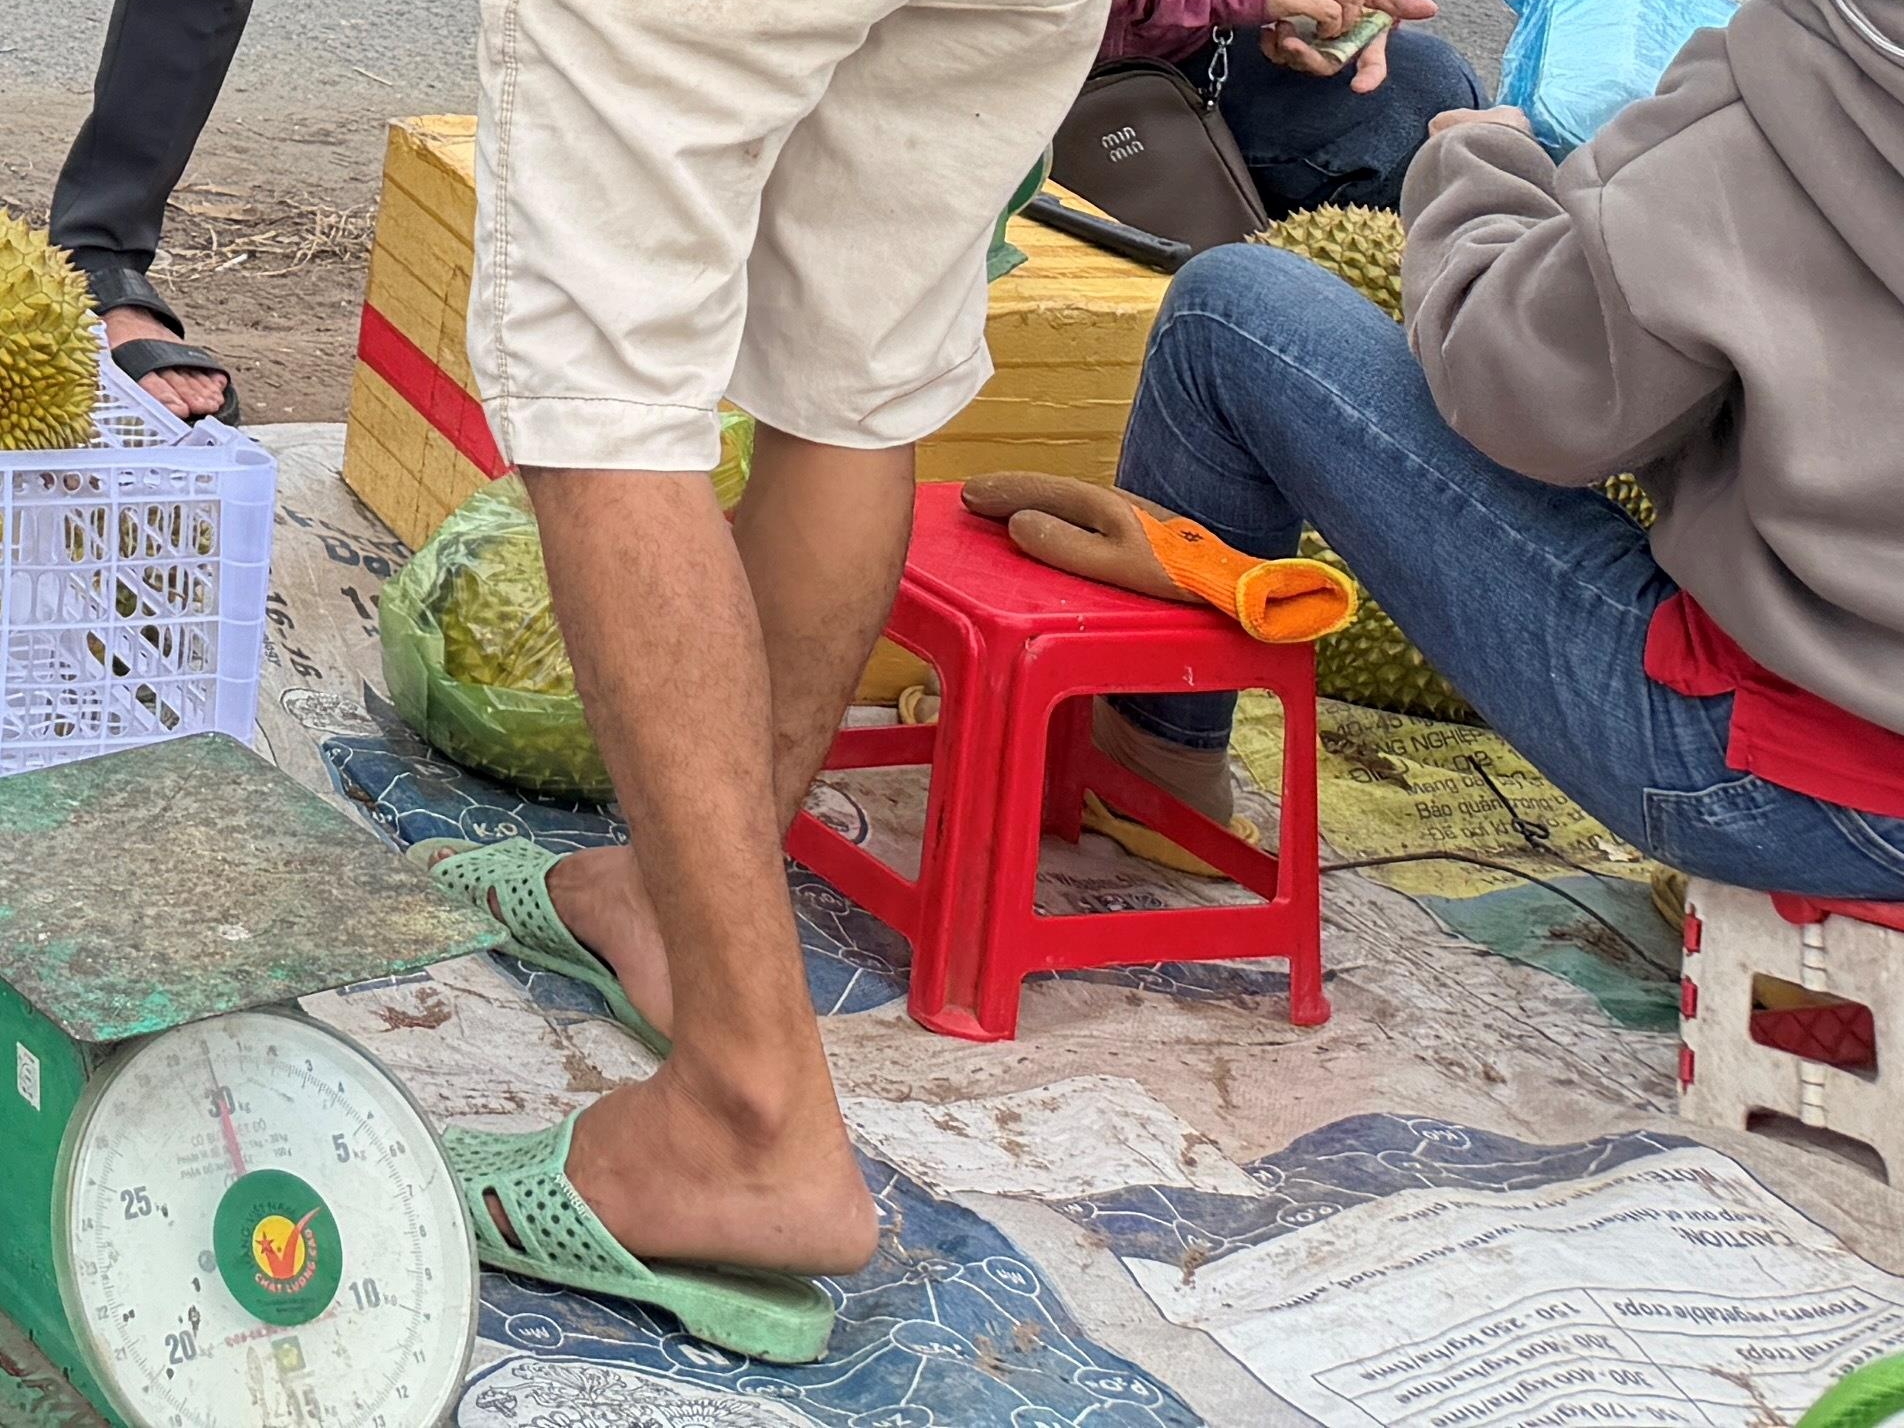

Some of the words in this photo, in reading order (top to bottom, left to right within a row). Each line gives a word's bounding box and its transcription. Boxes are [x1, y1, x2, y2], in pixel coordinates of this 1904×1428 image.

[1415, 796, 1453, 820] Bảo
[332, 1132, 351, 1164] 5
[120, 1186, 153, 1220] 25
[1670, 1226, 1793, 1248] CAUTION:
[349, 1277, 381, 1309] 10
[517, 1325, 550, 1340] Mn
[165, 1332, 198, 1366] 20
[1735, 1343, 1797, 1362] crops
[396, 1385, 410, 1400] 12
